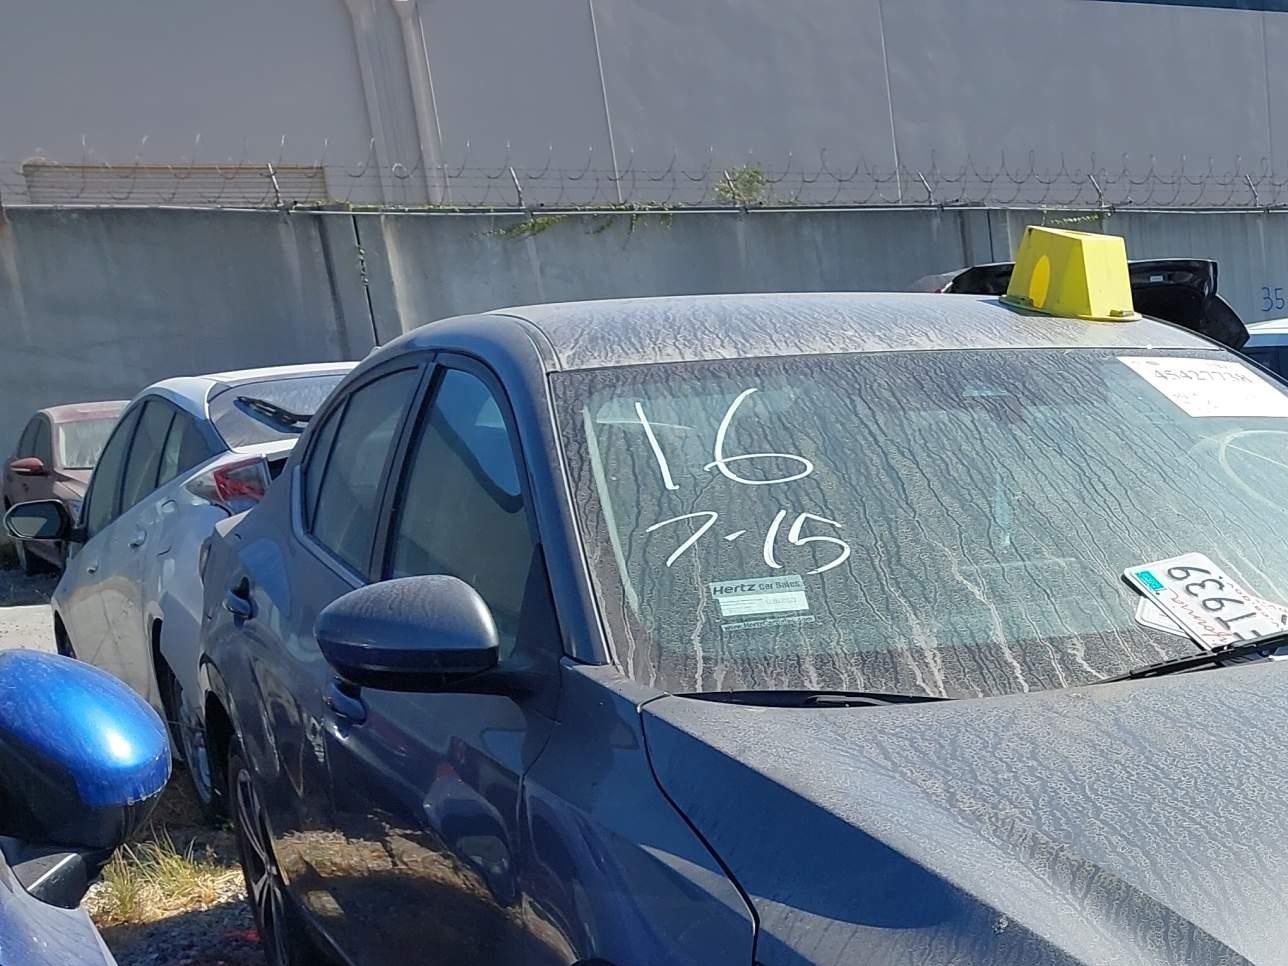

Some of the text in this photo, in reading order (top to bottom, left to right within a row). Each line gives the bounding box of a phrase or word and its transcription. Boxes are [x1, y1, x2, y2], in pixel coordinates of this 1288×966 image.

[1261, 286, 1286, 312] 35
[645, 509, 851, 575] 7-15
[713, 583, 756, 596] Hertz
